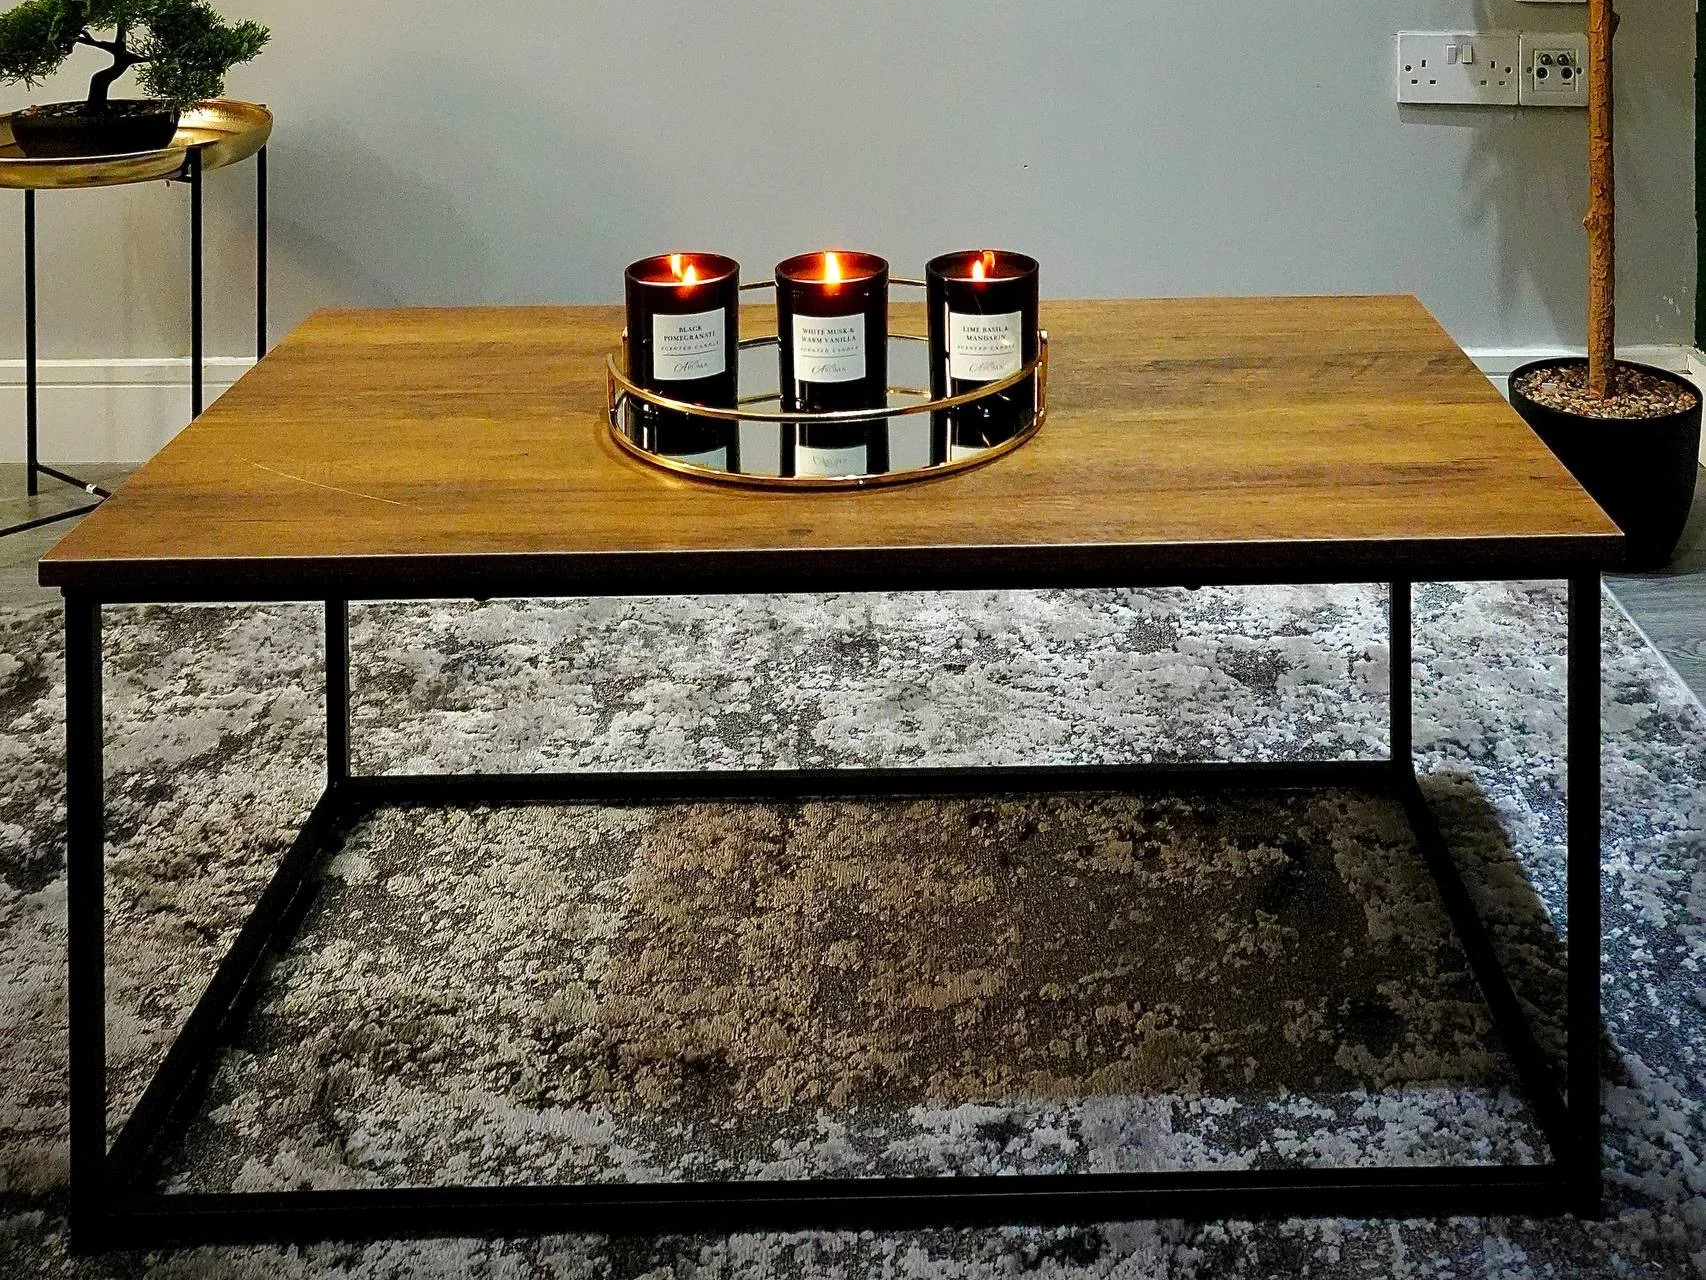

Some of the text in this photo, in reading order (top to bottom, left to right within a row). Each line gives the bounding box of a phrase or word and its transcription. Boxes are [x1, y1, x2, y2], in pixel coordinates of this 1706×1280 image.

[678, 325, 702, 333] BLACK
[802, 327, 824, 335] WHITE
[962, 325, 980, 333] LIME
[801, 335, 857, 344] WARM VANILLA
